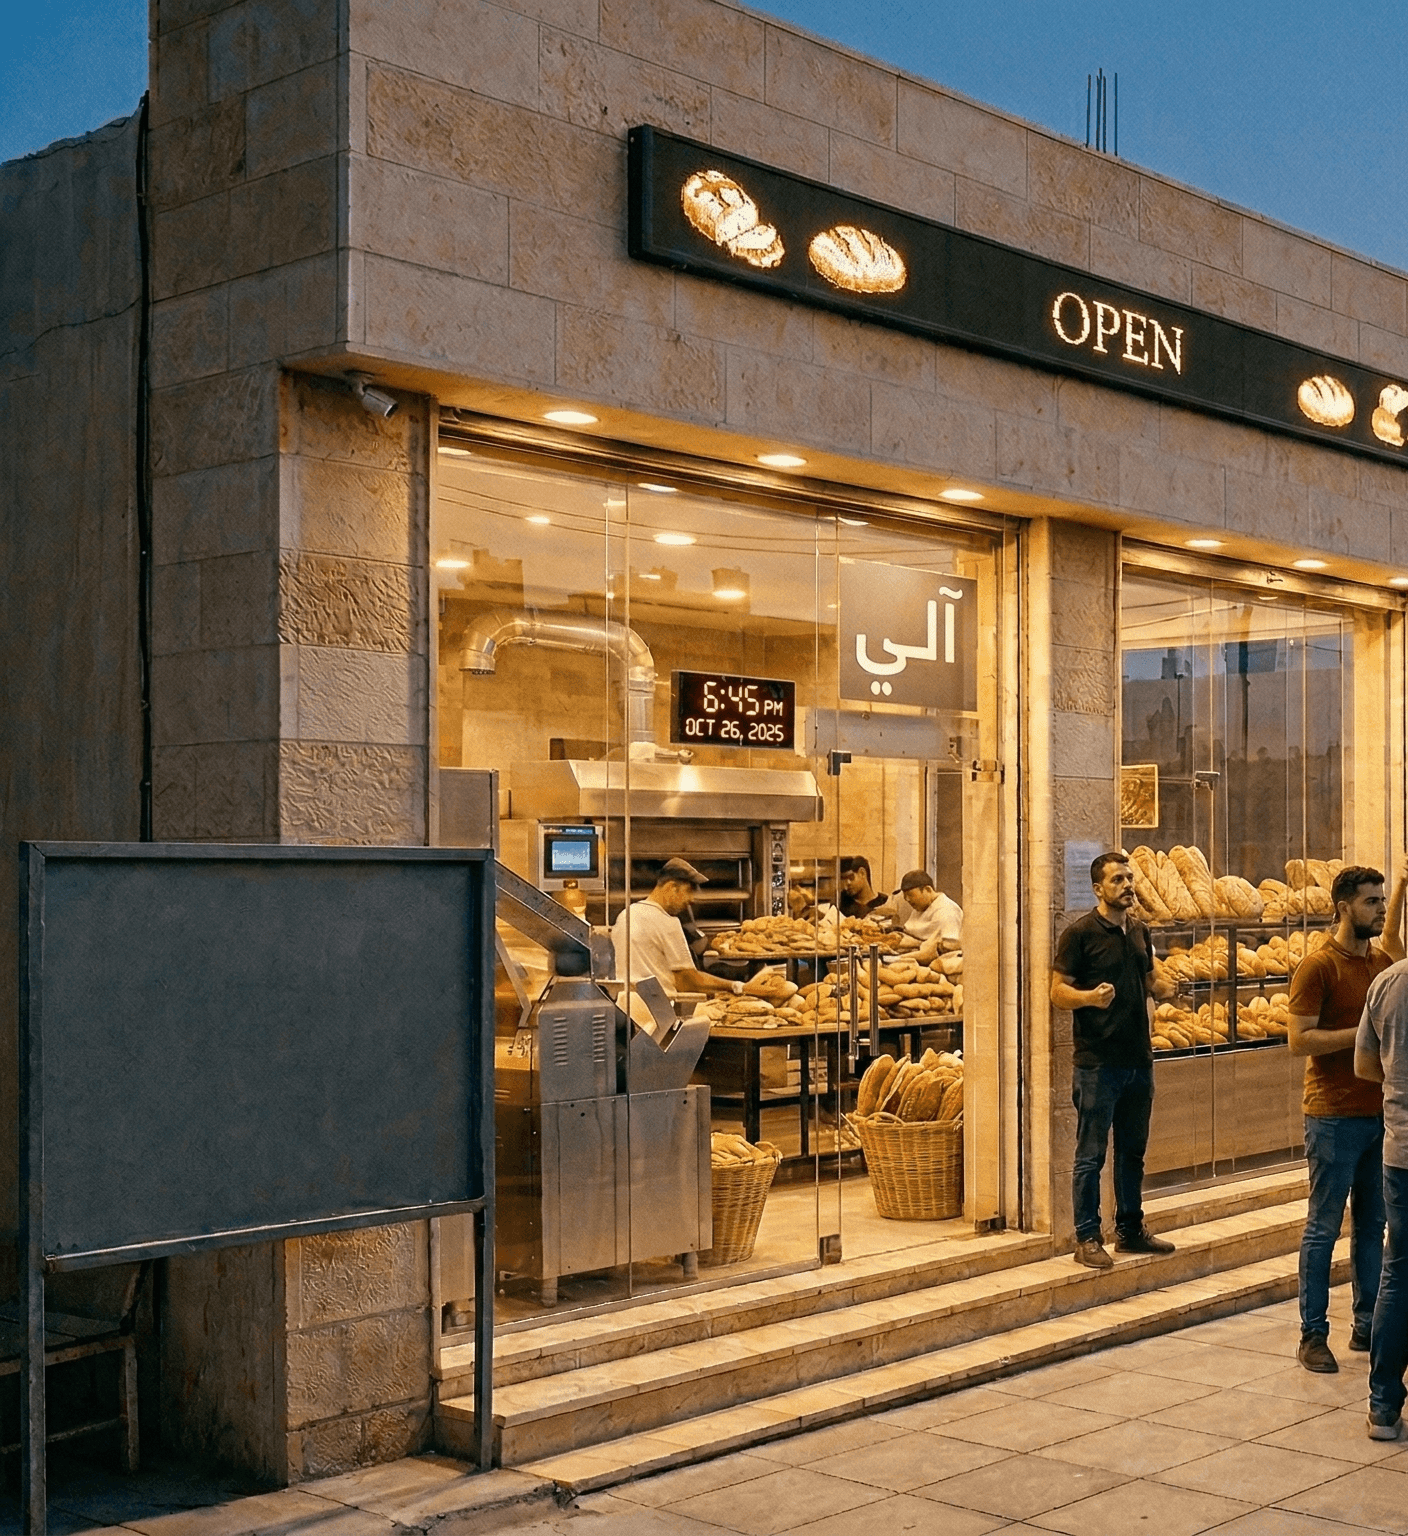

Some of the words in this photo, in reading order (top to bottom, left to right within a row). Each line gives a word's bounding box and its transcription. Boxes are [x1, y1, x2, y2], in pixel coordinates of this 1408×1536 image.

[1053, 292, 1183, 375] OPEN
[856, 586, 963, 696] آلي
[703, 681, 759, 716] 6:45
[764, 700, 783, 716] PM
[685, 718, 716, 736] OCT
[720, 720, 744, 739] 26,
[748, 723, 784, 742] 2025
